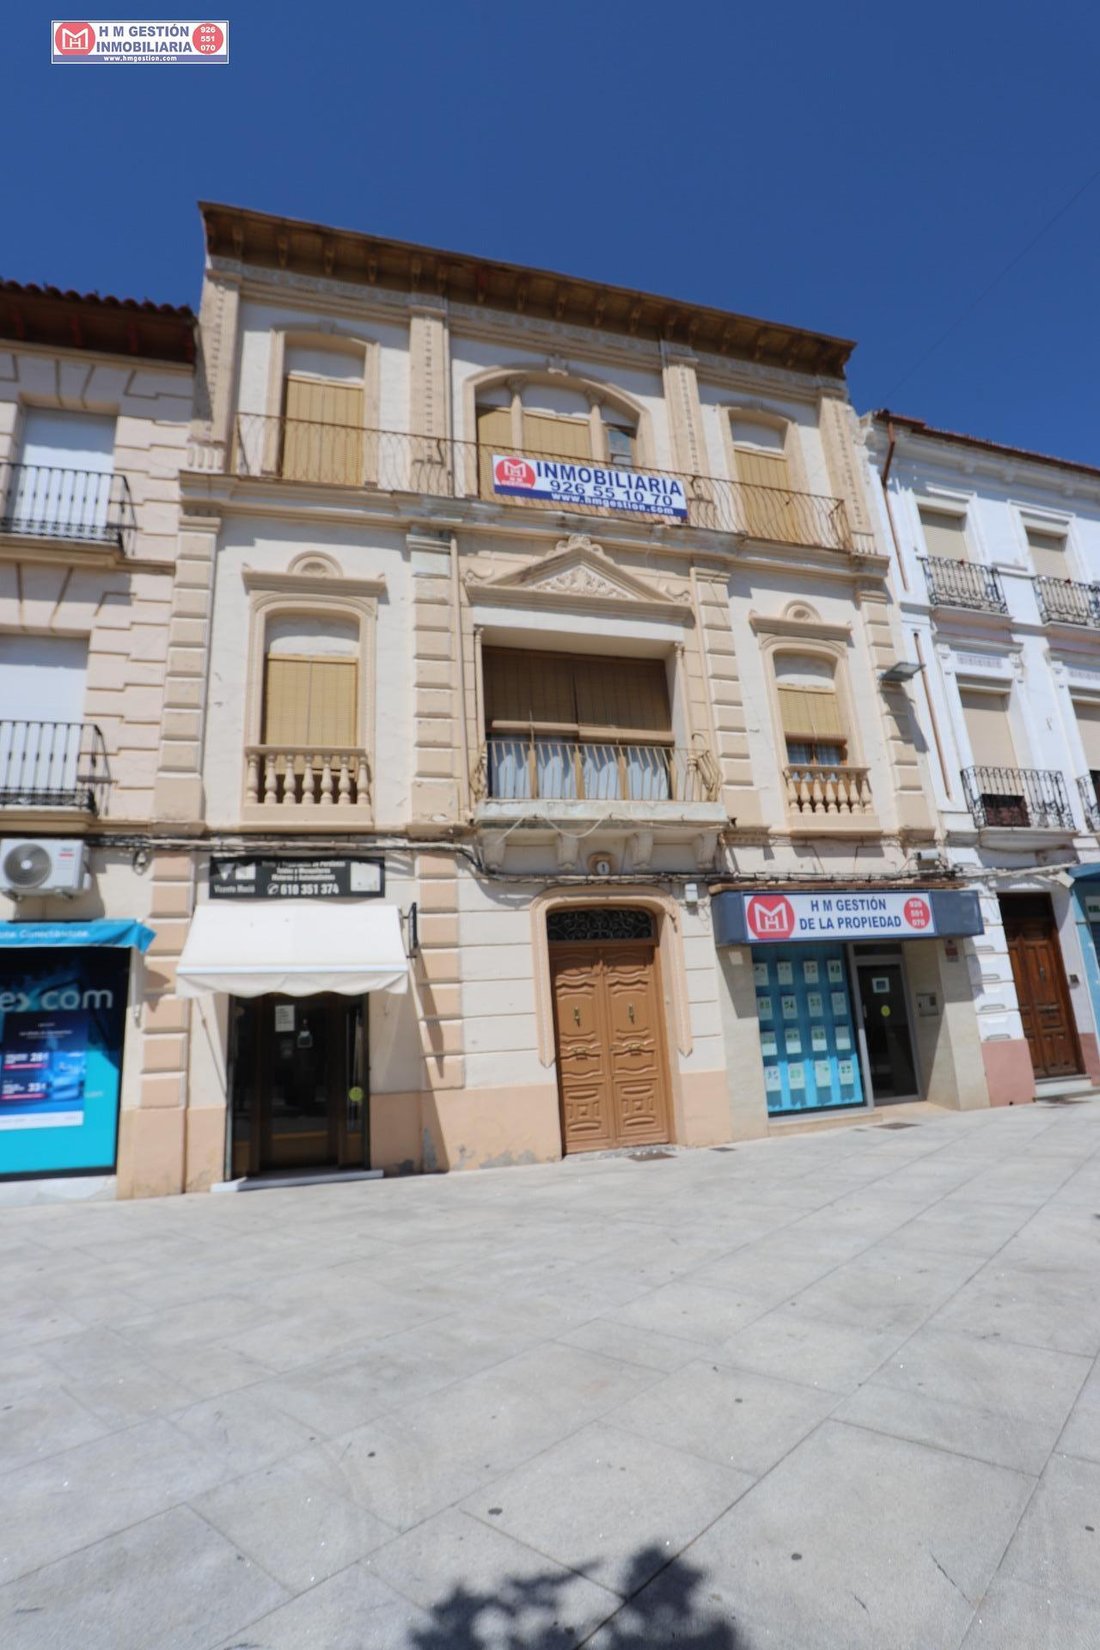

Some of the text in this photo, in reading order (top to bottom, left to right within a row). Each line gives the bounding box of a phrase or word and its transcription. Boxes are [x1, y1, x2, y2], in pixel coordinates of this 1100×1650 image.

[536, 461, 682, 496] INMOBILIARIA
[550, 480, 673, 507] 926 55 10 70
[551, 492, 674, 515] www.hmgestion.com
[301, 883, 319, 895] 351
[811, 896, 887, 912] H M GESTIÓN
[800, 915, 902, 930] DE LA PROPIEDAD
